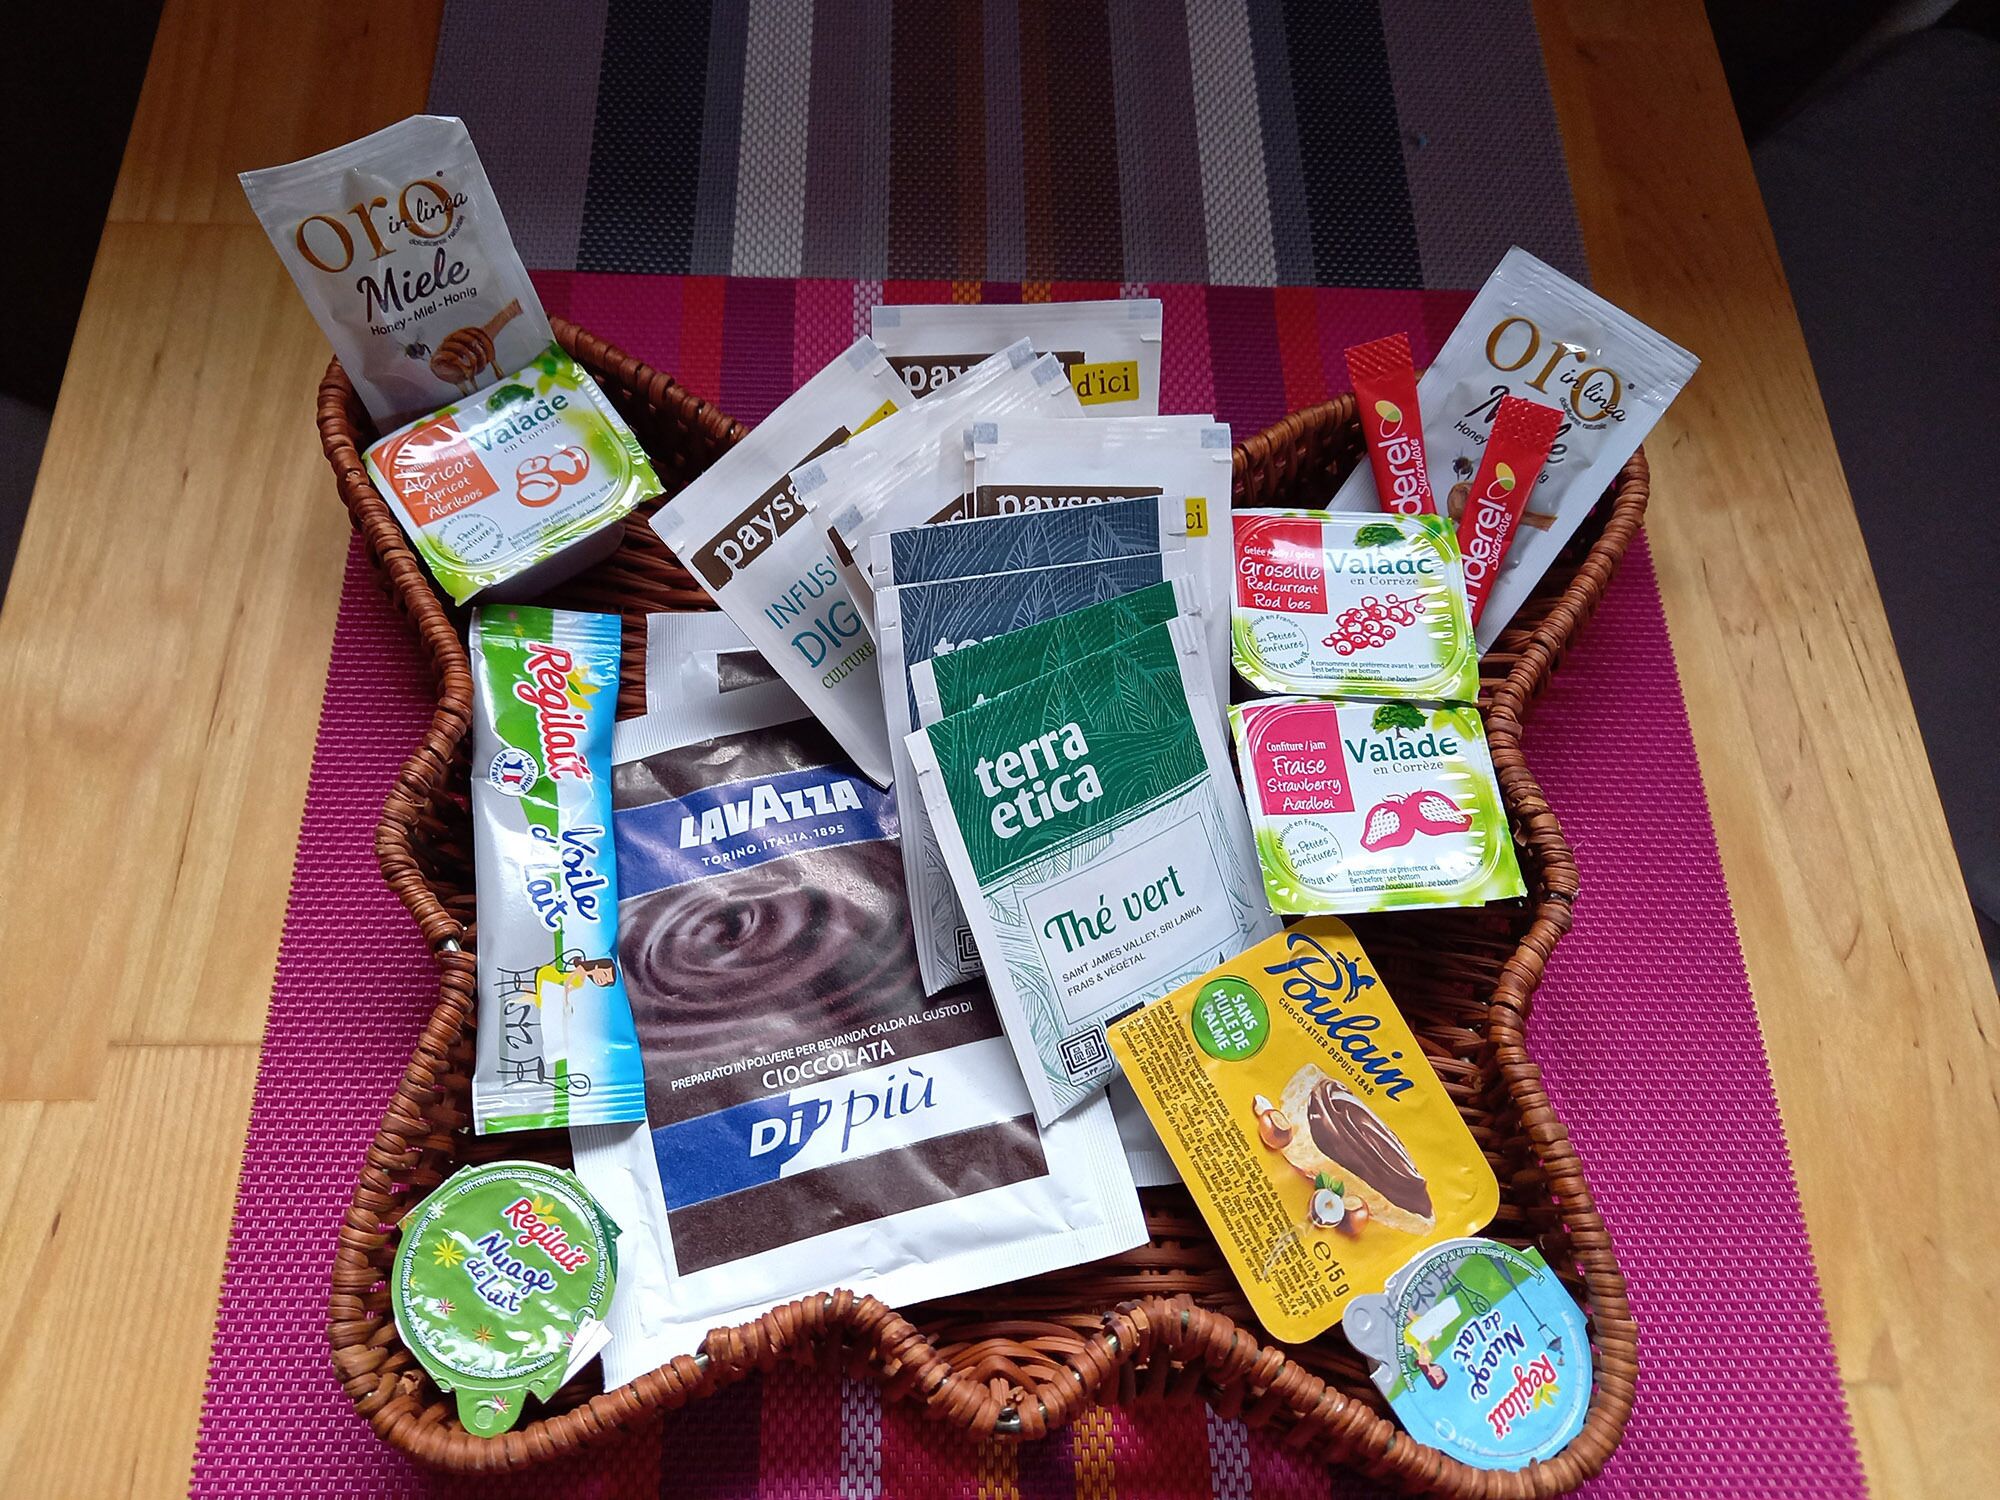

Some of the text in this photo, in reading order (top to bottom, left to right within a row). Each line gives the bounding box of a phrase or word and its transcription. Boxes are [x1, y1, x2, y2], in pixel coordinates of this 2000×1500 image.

[389, 193, 468, 234] in linea
[356, 247, 470, 323] Miele
[371, 286, 477, 336] Honey Miel Honig
[1076, 368, 1131, 397] d'ici
[1560, 369, 1627, 423] in linea
[470, 394, 569, 453] Valade
[503, 418, 563, 455] en Corrèze
[1454, 420, 1489, 446] Honey
[403, 456, 474, 497] Abricot
[423, 476, 472, 505] Apricot
[1379, 434, 1423, 515] derel
[1410, 438, 1431, 497] Sucralose
[429, 488, 484, 520] Abrikoos
[1244, 546, 1266, 557] Gelée
[1487, 512, 1513, 572] Sucralose
[1239, 556, 1321, 580] Groseille
[1245, 576, 1319, 595] Redcurrant
[1350, 576, 1419, 586] en Corrèze
[1253, 593, 1311, 610] Rod bes
[791, 600, 863, 669] DIG
[1257, 640, 1305, 654] Confitures
[821, 642, 876, 690] CULTURE
[517, 643, 591, 779] Regilait
[974, 722, 1089, 799] terra
[1266, 741, 1303, 752] Confiture
[1309, 740, 1327, 753] jam
[1272, 755, 1327, 776] Fraise
[1345, 733, 1458, 763] Valade
[1373, 760, 1444, 775] en Corrèze
[491, 762, 504, 786] Fran
[1266, 777, 1341, 795] Strawberry
[679, 780, 864, 849] LAVAZZA
[990, 765, 1104, 839] etica
[1282, 796, 1335, 813] Aardbei
[1294, 819, 1303, 827] en
[1304, 818, 1329, 832] France
[813, 824, 846, 839] 1895
[1298, 837, 1329, 853] Petites
[562, 827, 605, 920] Voile
[1291, 847, 1338, 870] Confitures
[1363, 875, 1382, 883] before
[1437, 878, 1458, 886] bodem
[524, 863, 568, 928] Lait
[1043, 865, 1186, 954] Thé vert
[1062, 904, 1203, 983] SAINT JAMES VALLEY, SRI LANKA
[1067, 952, 1147, 997] FRAIS & VÉGÉTAL
[1202, 1003, 1231, 1051] PALME
[1212, 988, 1251, 1051] HUILE DE
[1231, 993, 1259, 1031] SANS
[1264, 932, 1415, 1102] Poulain
[671, 1001, 973, 1091] PREPARATO IN POLVERE PER BEVANDA CALDA AL GUSTO DI
[762, 1038, 896, 1090] CIOCCOLATA
[1278, 997, 1375, 1096] CHOCOLATIER DEPUIS 1848
[841, 1066, 937, 1153] più
[503, 1197, 590, 1273] Regilait
[467, 1260, 521, 1312] de Lait
[477, 1233, 557, 1294] Nuage
[1324, 1260, 1350, 1297] 15 g
[1453, 1311, 1501, 1361] de Lait
[1470, 1324, 1526, 1400] Nuage
[1488, 1353, 1558, 1440] Regilait
